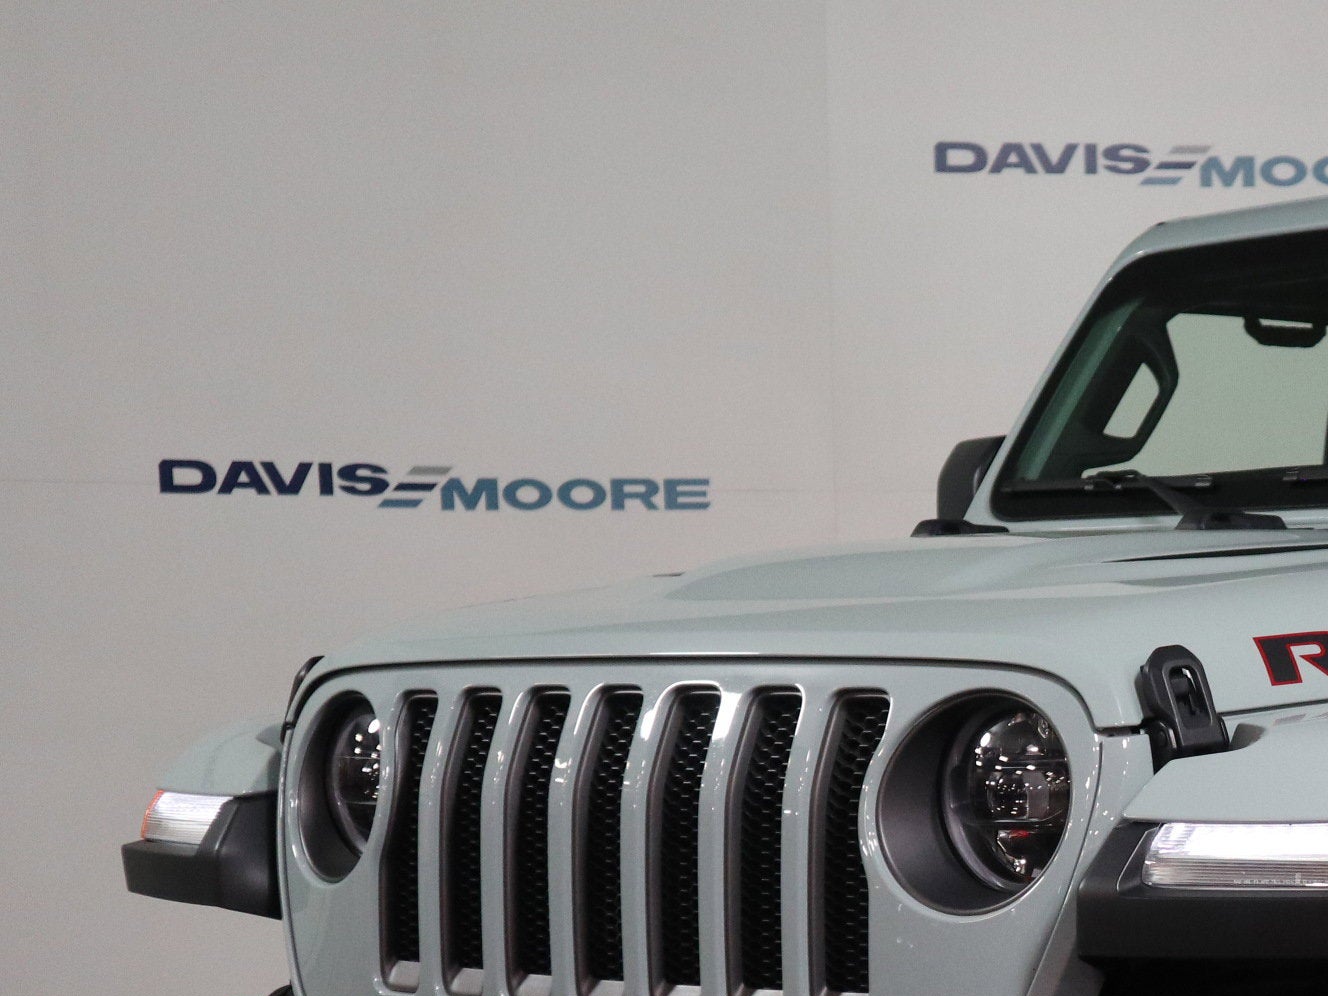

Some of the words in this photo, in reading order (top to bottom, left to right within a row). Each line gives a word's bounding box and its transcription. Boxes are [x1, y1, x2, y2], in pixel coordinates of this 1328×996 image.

[933, 140, 1152, 175] DAVIS
[158, 459, 390, 497] DAVIS
[440, 477, 711, 512] MOORE
